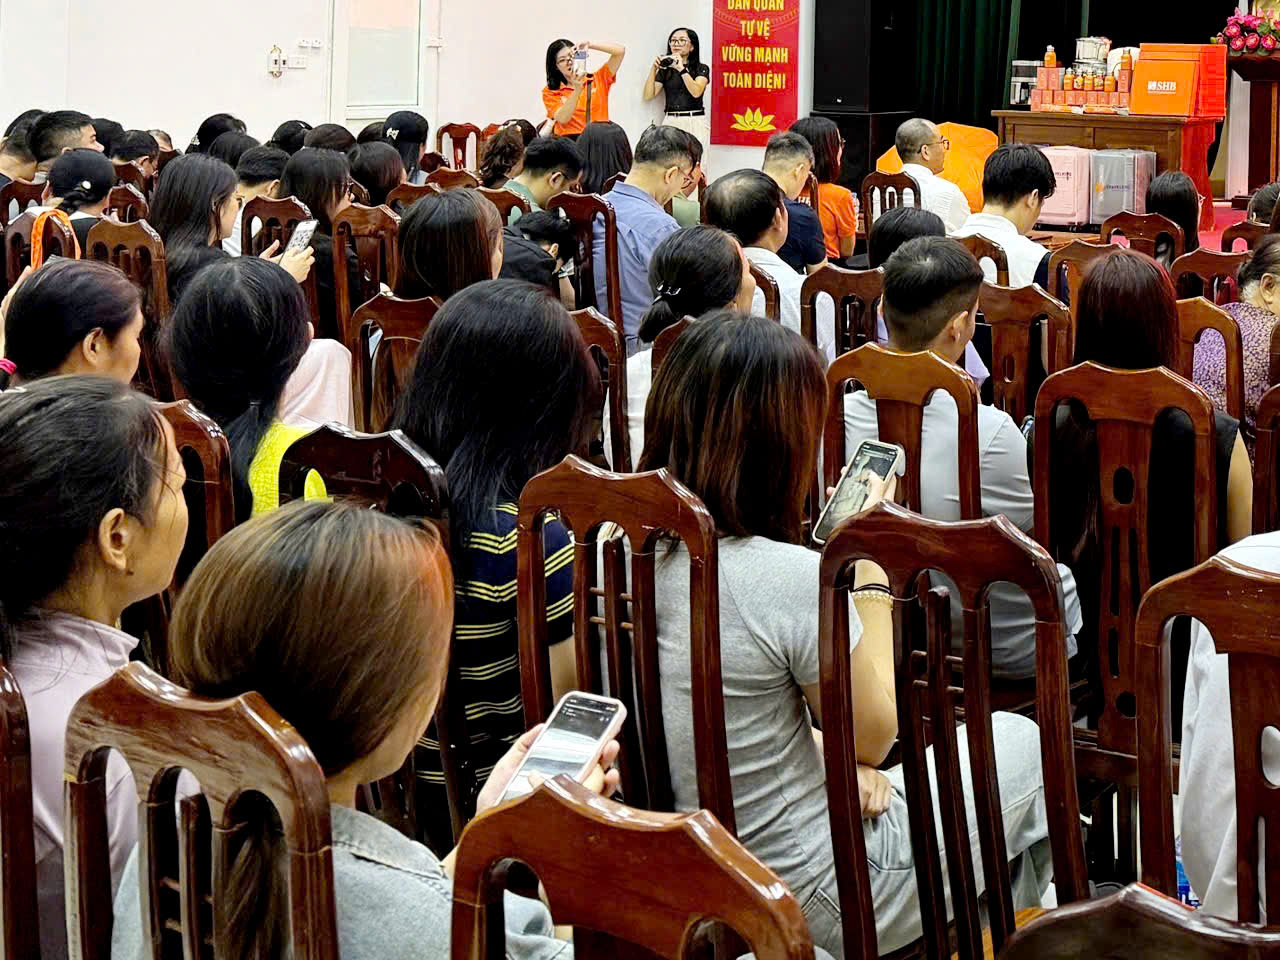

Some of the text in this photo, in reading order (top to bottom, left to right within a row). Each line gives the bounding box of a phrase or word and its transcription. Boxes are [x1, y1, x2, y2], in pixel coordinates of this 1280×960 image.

[740, 18, 770, 40] TỰ VỆ
[721, 43, 788, 66] VỮNG MẠNH
[723, 70, 786, 92] TOÀN DIỆN!
[1157, 81, 1177, 91] SHB
